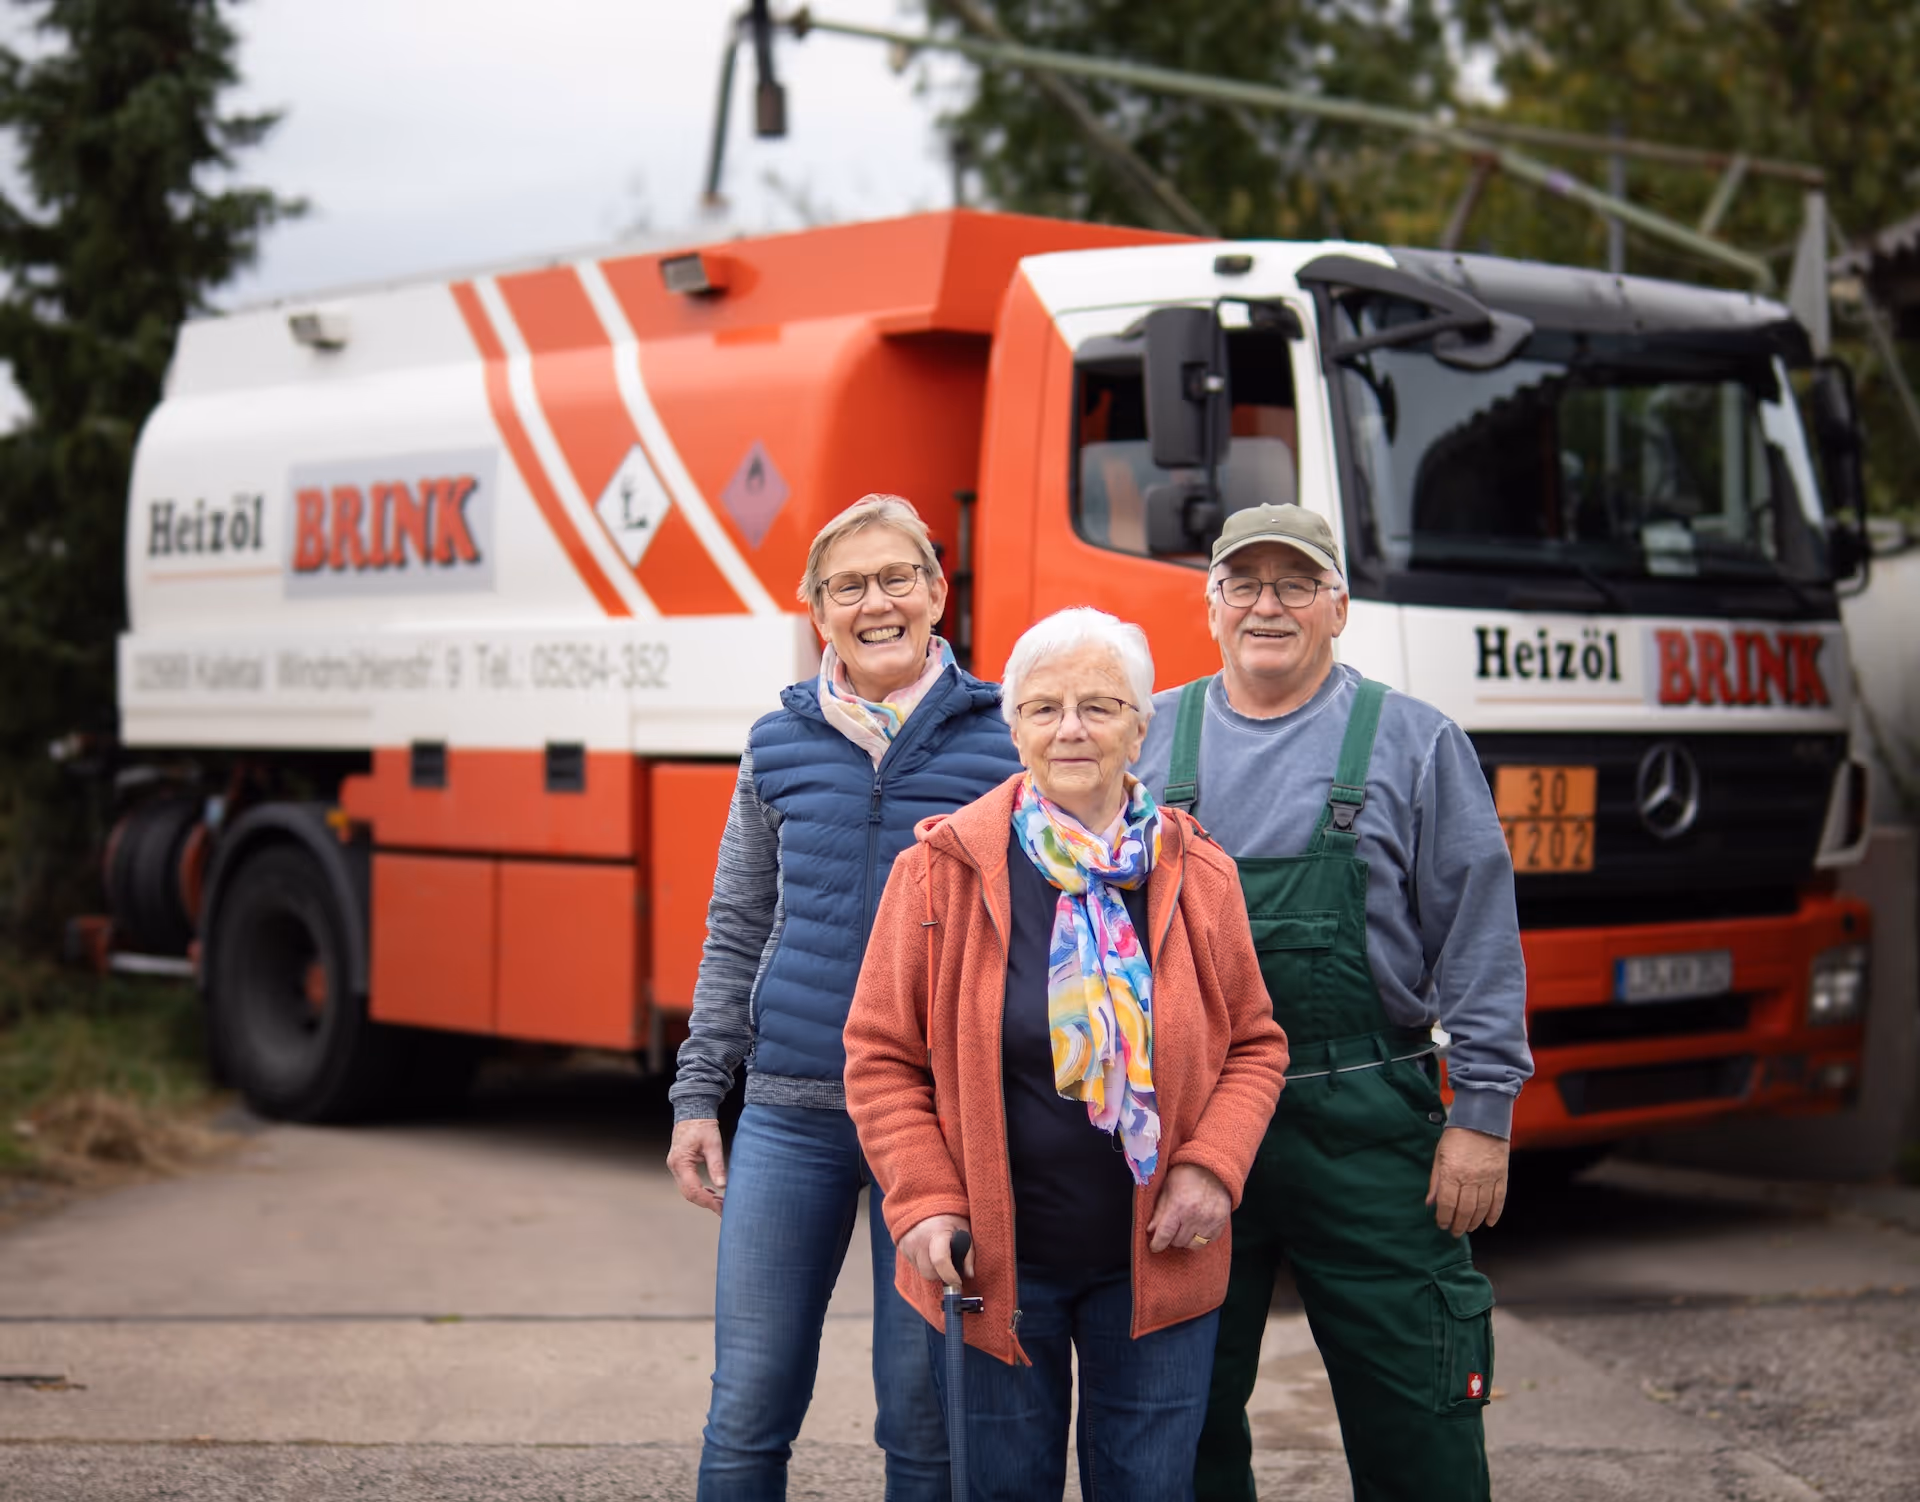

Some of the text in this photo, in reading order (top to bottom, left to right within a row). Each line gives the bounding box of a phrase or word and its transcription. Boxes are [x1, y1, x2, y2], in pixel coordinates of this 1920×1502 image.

[149, 475, 480, 572] Heizöl BRINK
[1474, 625, 1832, 707] Heizöl BRINK
[1527, 770, 1567, 814] 30
